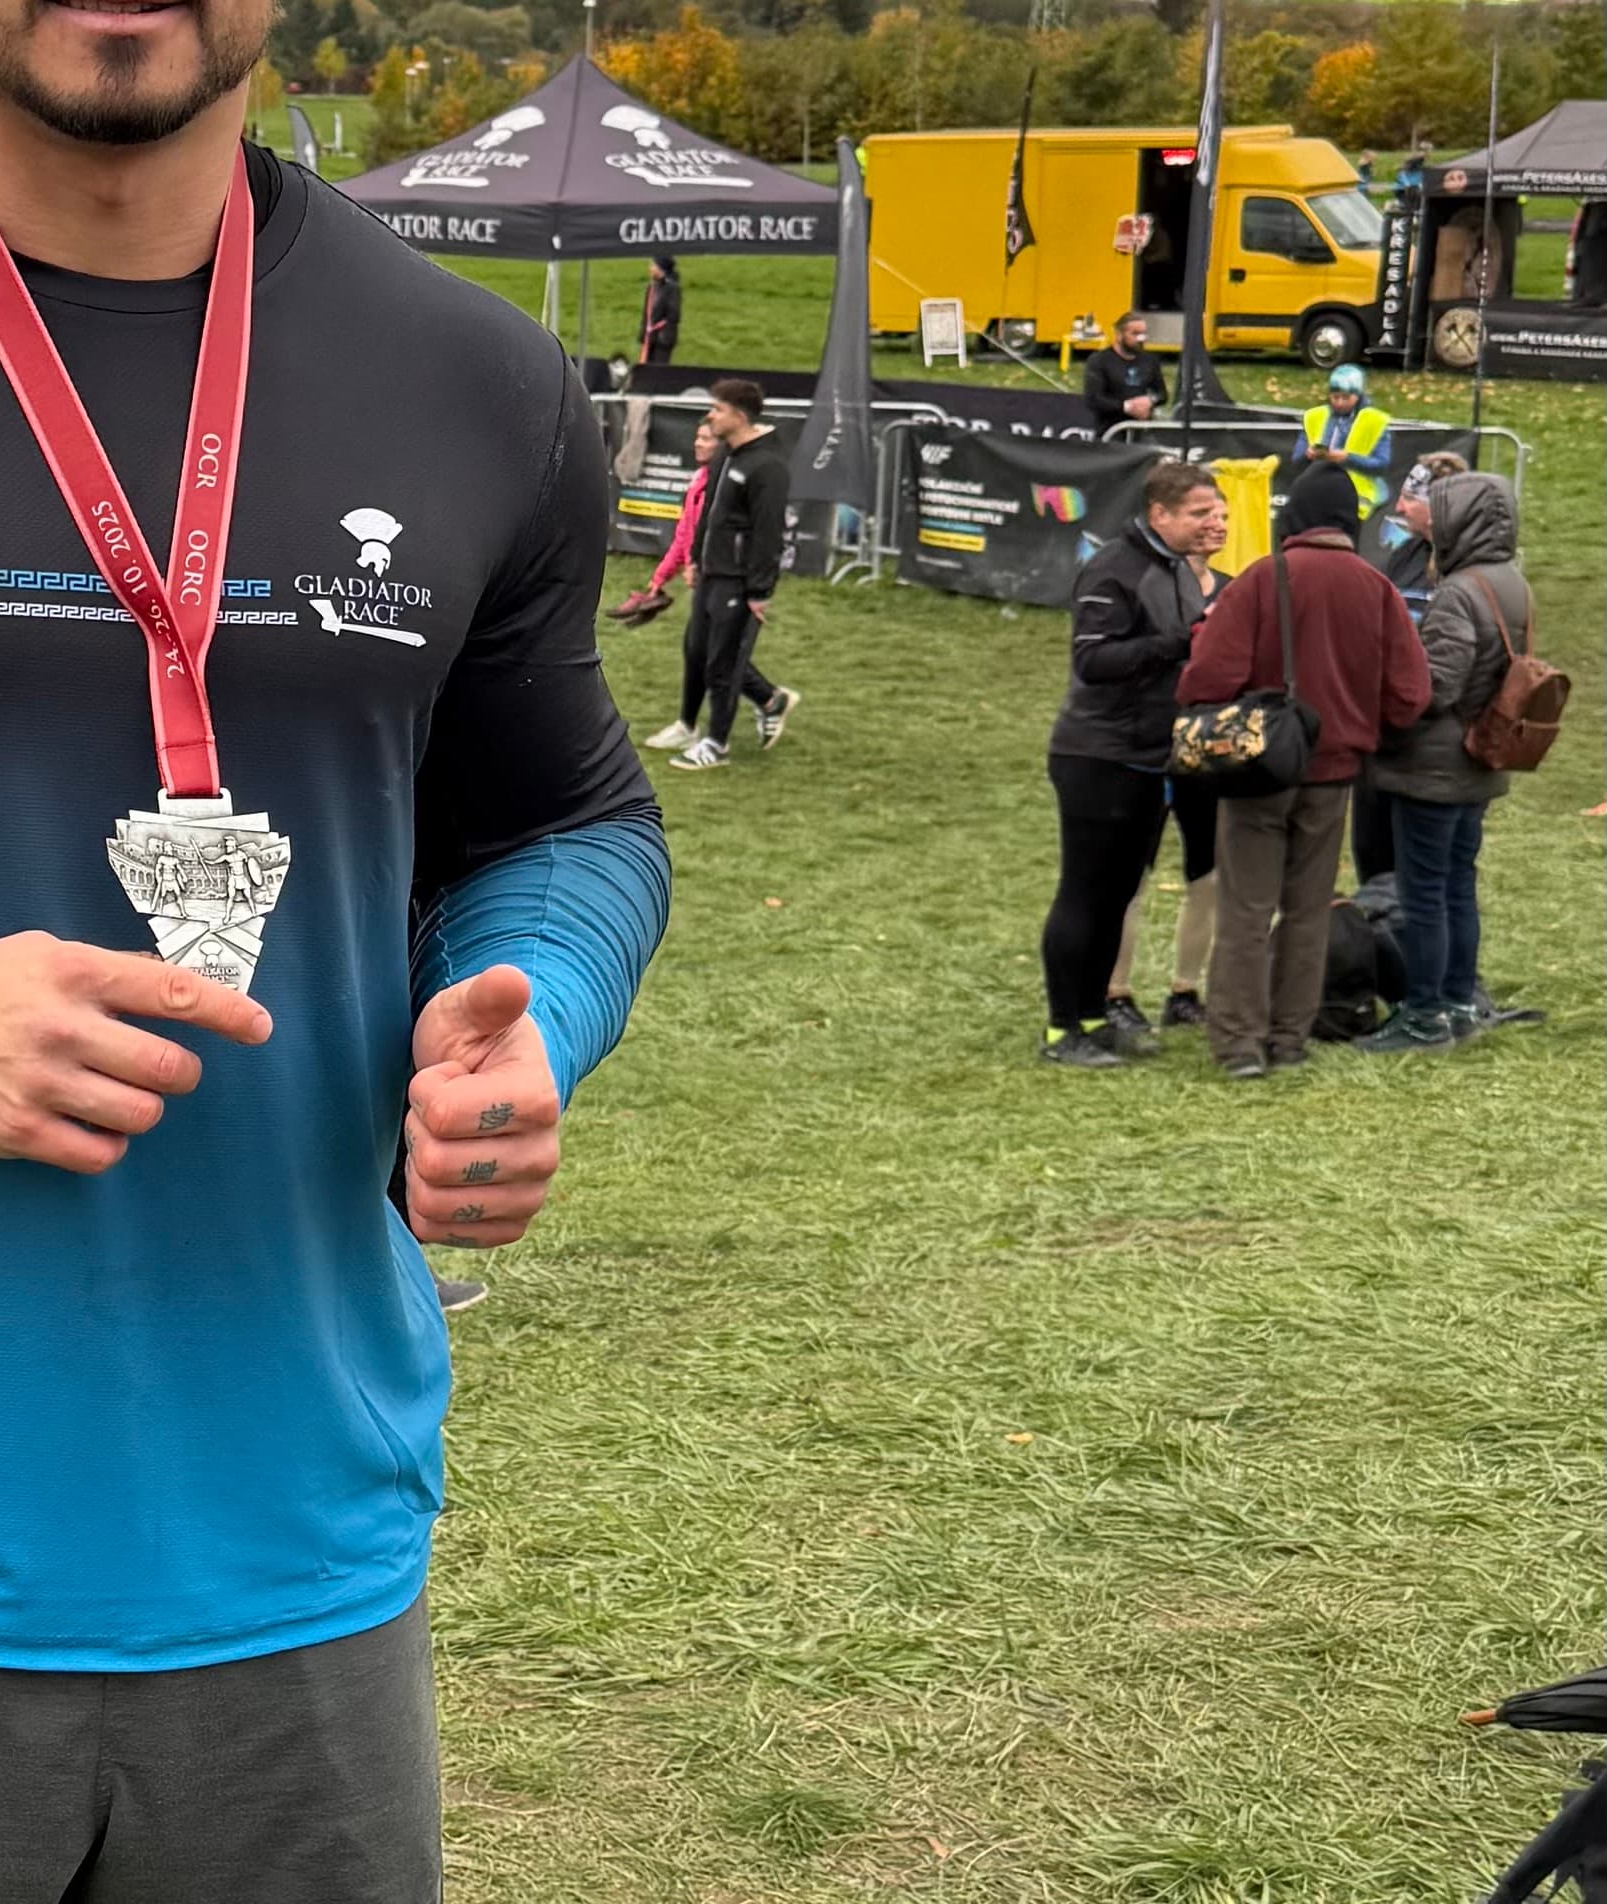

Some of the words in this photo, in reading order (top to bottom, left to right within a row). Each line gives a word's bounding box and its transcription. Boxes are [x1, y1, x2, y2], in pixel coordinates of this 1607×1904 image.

[447, 217, 497, 243] RACE
[619, 216, 754, 243] GLADIATOR
[759, 217, 814, 241] RACE
[195, 432, 222, 490] OCR
[91, 500, 131, 559] 2025
[179, 528, 209, 607] OCRC
[294, 574, 433, 609] GLADIATOR
[343, 599, 400, 626] RACE
